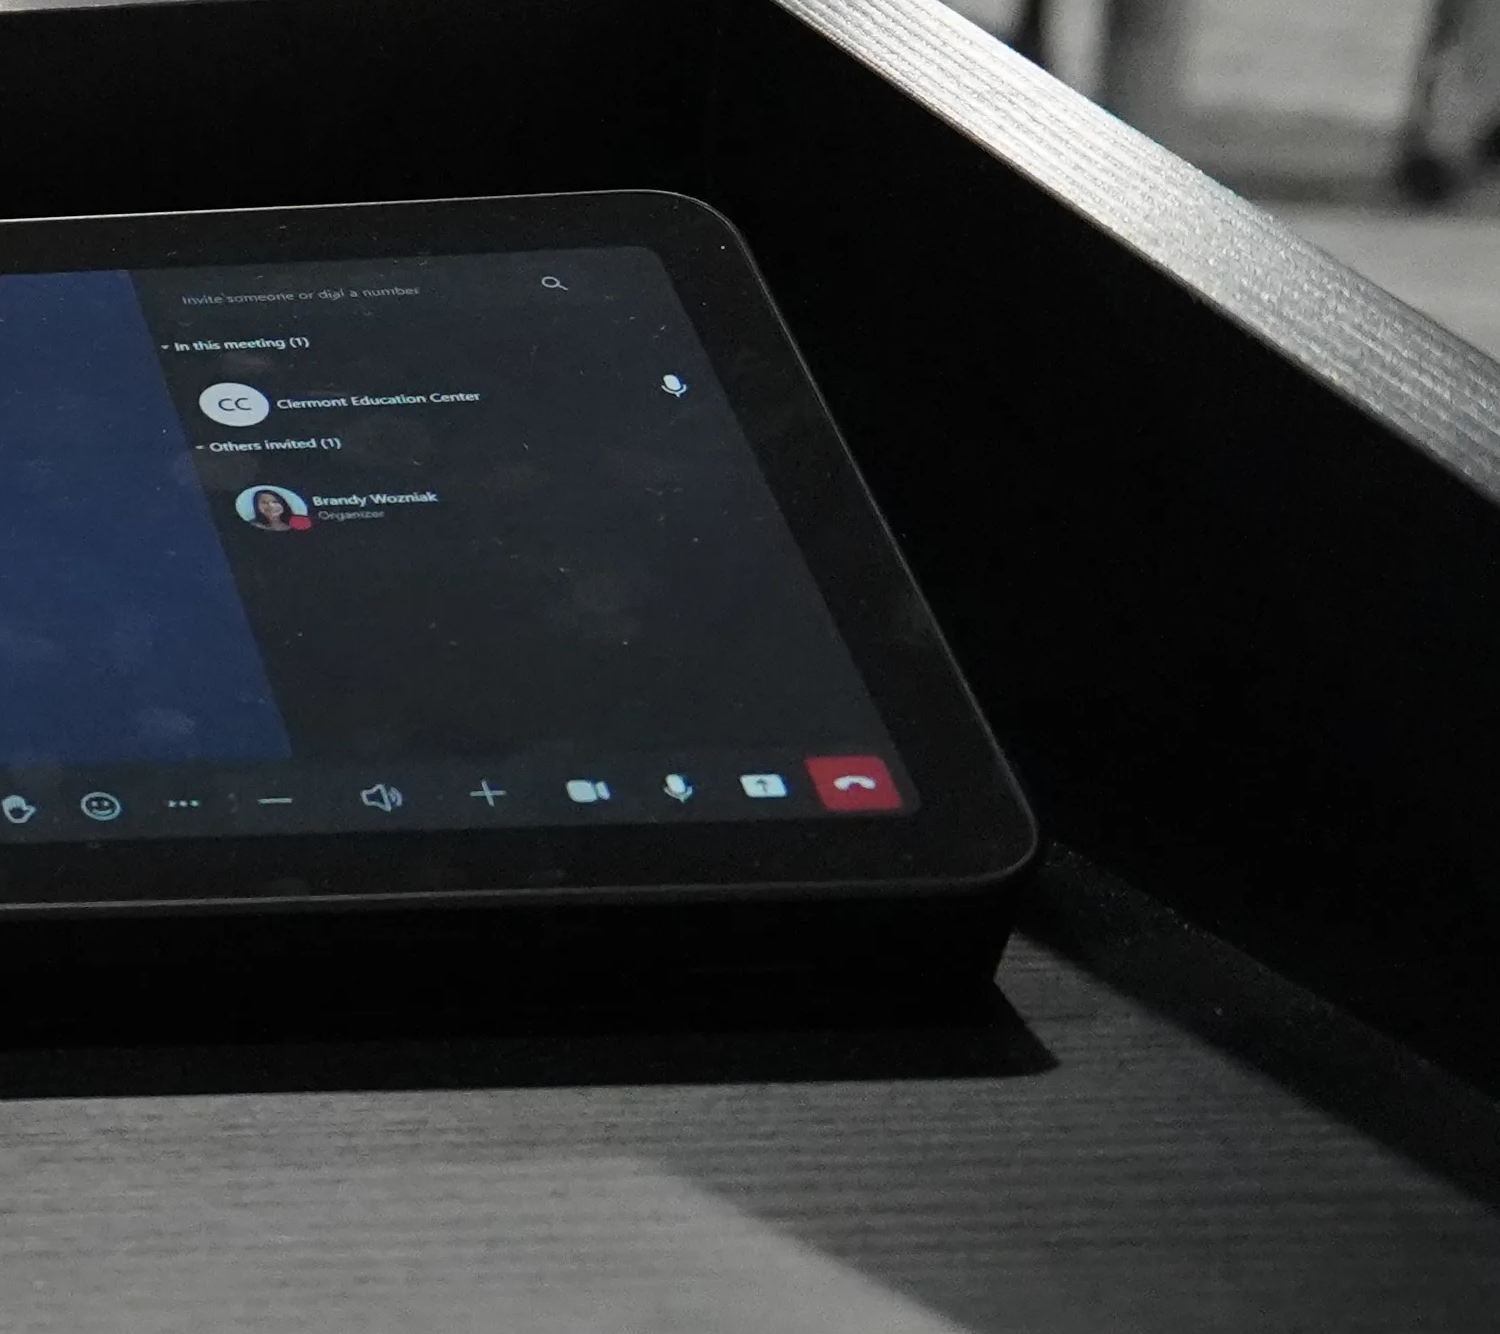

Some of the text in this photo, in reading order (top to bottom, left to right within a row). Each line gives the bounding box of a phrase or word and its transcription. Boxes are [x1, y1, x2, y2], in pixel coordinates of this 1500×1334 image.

[182, 286, 420, 307] Invite someone or dial a number
[174, 336, 310, 352] In this meeting (1)
[218, 397, 252, 412] CC
[276, 391, 481, 410] Clermont Education Center
[209, 436, 342, 453] Others invited (1)
[312, 491, 438, 508] Brandy Wozniak
[318, 509, 385, 522] Organizer
